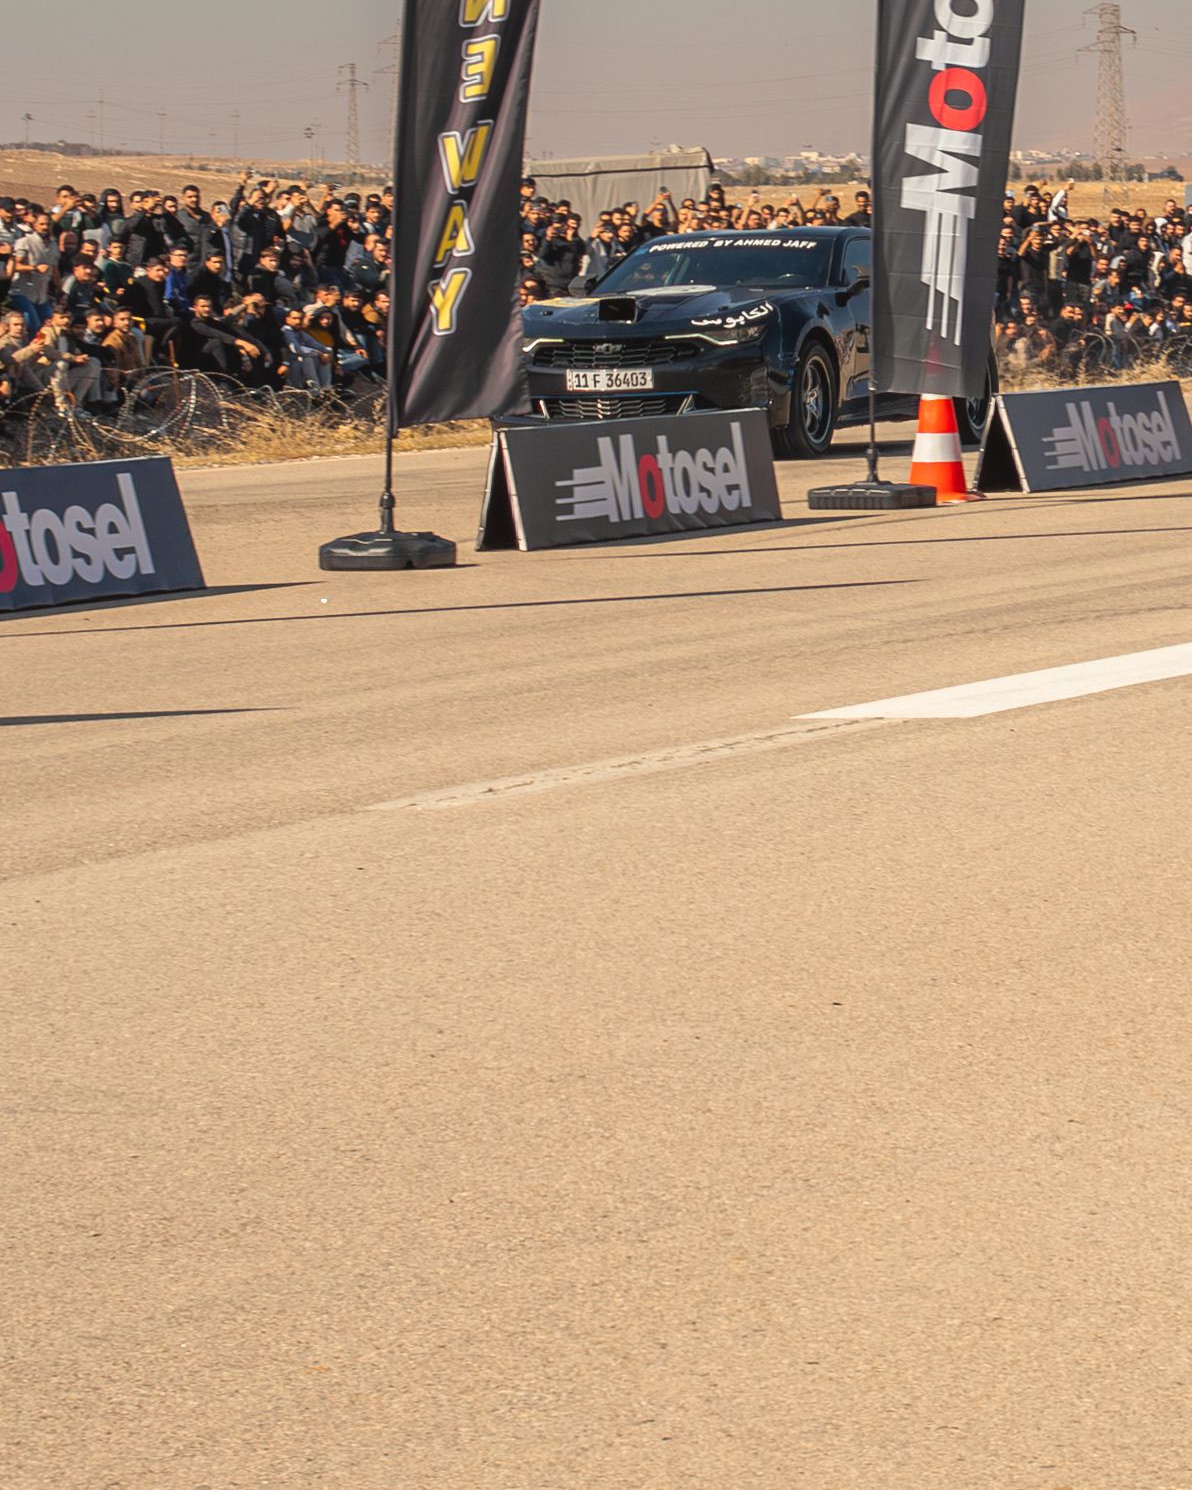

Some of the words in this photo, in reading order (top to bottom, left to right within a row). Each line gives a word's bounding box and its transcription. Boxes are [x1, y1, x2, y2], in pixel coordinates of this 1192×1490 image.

[649, 240, 709, 253] POWERED
[713, 239, 734, 247] BY
[734, 239, 782, 247] AHMED
[782, 239, 817, 249] JAFF
[574, 373, 589, 388] 11
[593, 374, 600, 387] F
[606, 371, 647, 388] 36403
[597, 421, 752, 523] Motosel
[1064, 390, 1182, 472] Motosel
[0, 472, 156, 593] tosel
